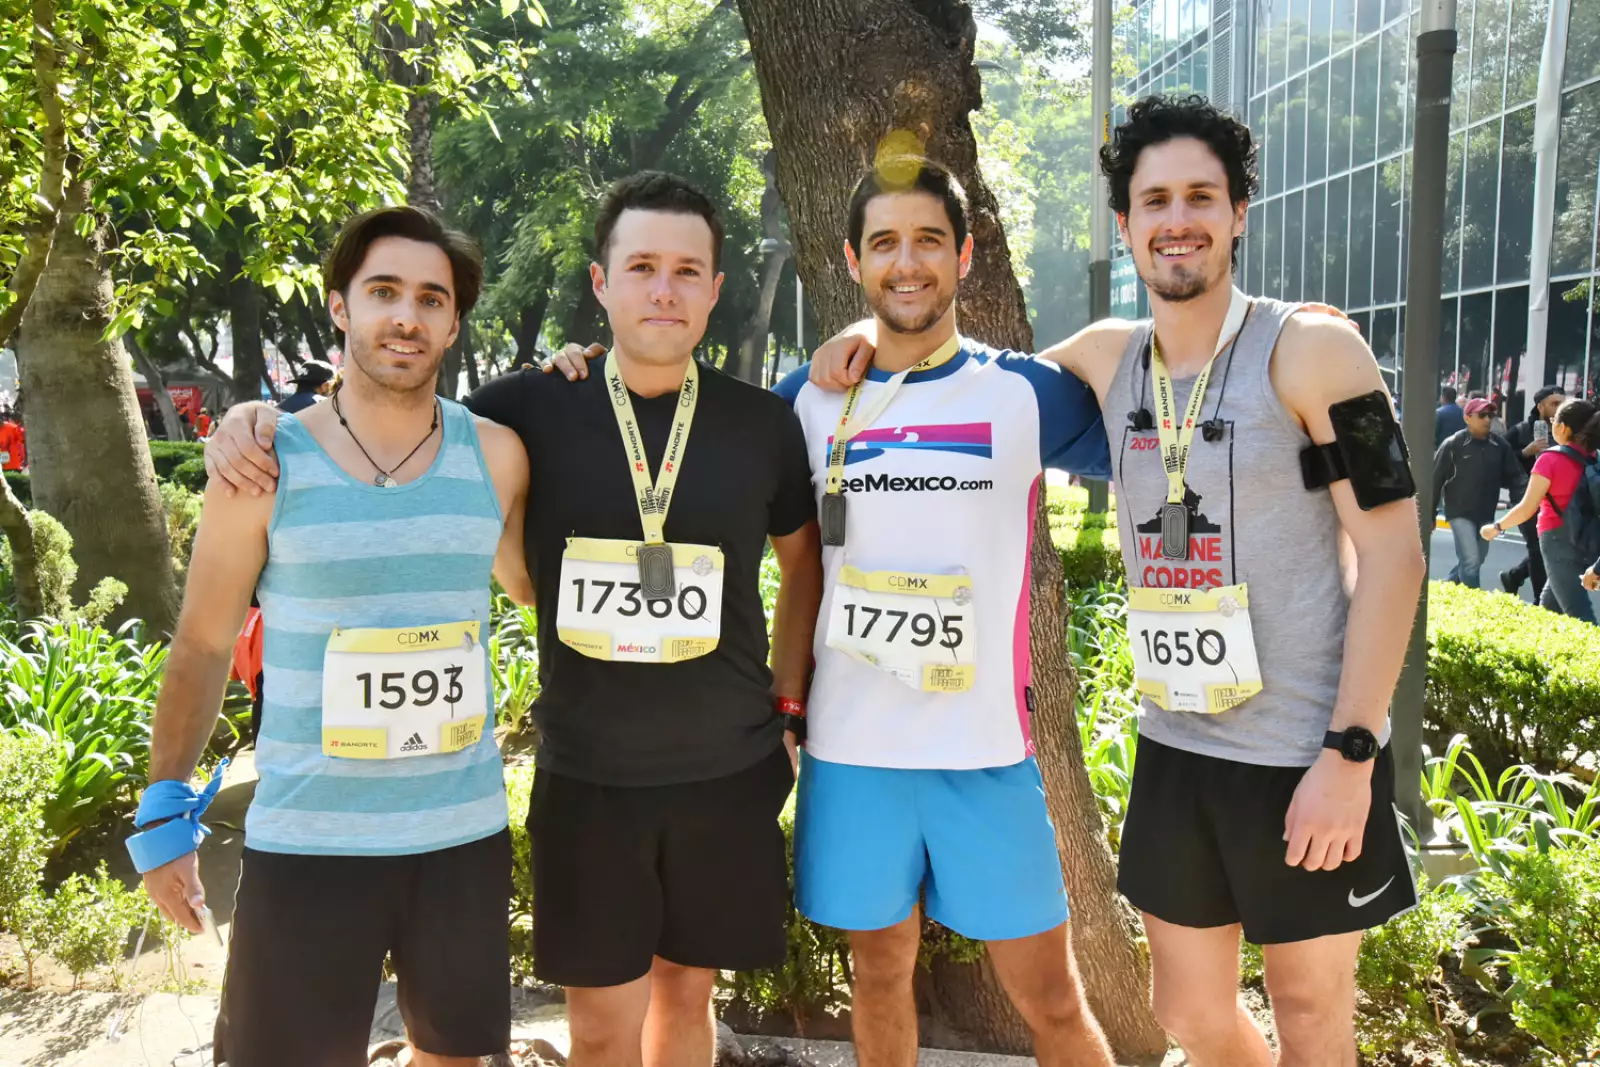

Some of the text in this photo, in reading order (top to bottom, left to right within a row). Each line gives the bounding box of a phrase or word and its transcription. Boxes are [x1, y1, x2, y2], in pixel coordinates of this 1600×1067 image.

[610, 373, 626, 407] CDMX
[680, 376, 694, 408] CDMX
[1159, 375, 1170, 417] BANORTE
[625, 419, 641, 461] BANORTE
[669, 421, 685, 462] BANORTE
[1130, 436, 1160, 451] 2017
[826, 474, 992, 493] eeMexico.com
[1139, 535, 1222, 562] MANE
[888, 575, 928, 589] CDMX
[1143, 565, 1223, 592] CORPS
[1160, 593, 1191, 605] CDMX
[397, 630, 440, 645] CDMX
[844, 604, 963, 649] 17795
[617, 643, 656, 654] MÉXICO
[1141, 629, 1226, 666] 1650
[356, 665, 463, 710] 1593
[400, 743, 428, 752] adidas
